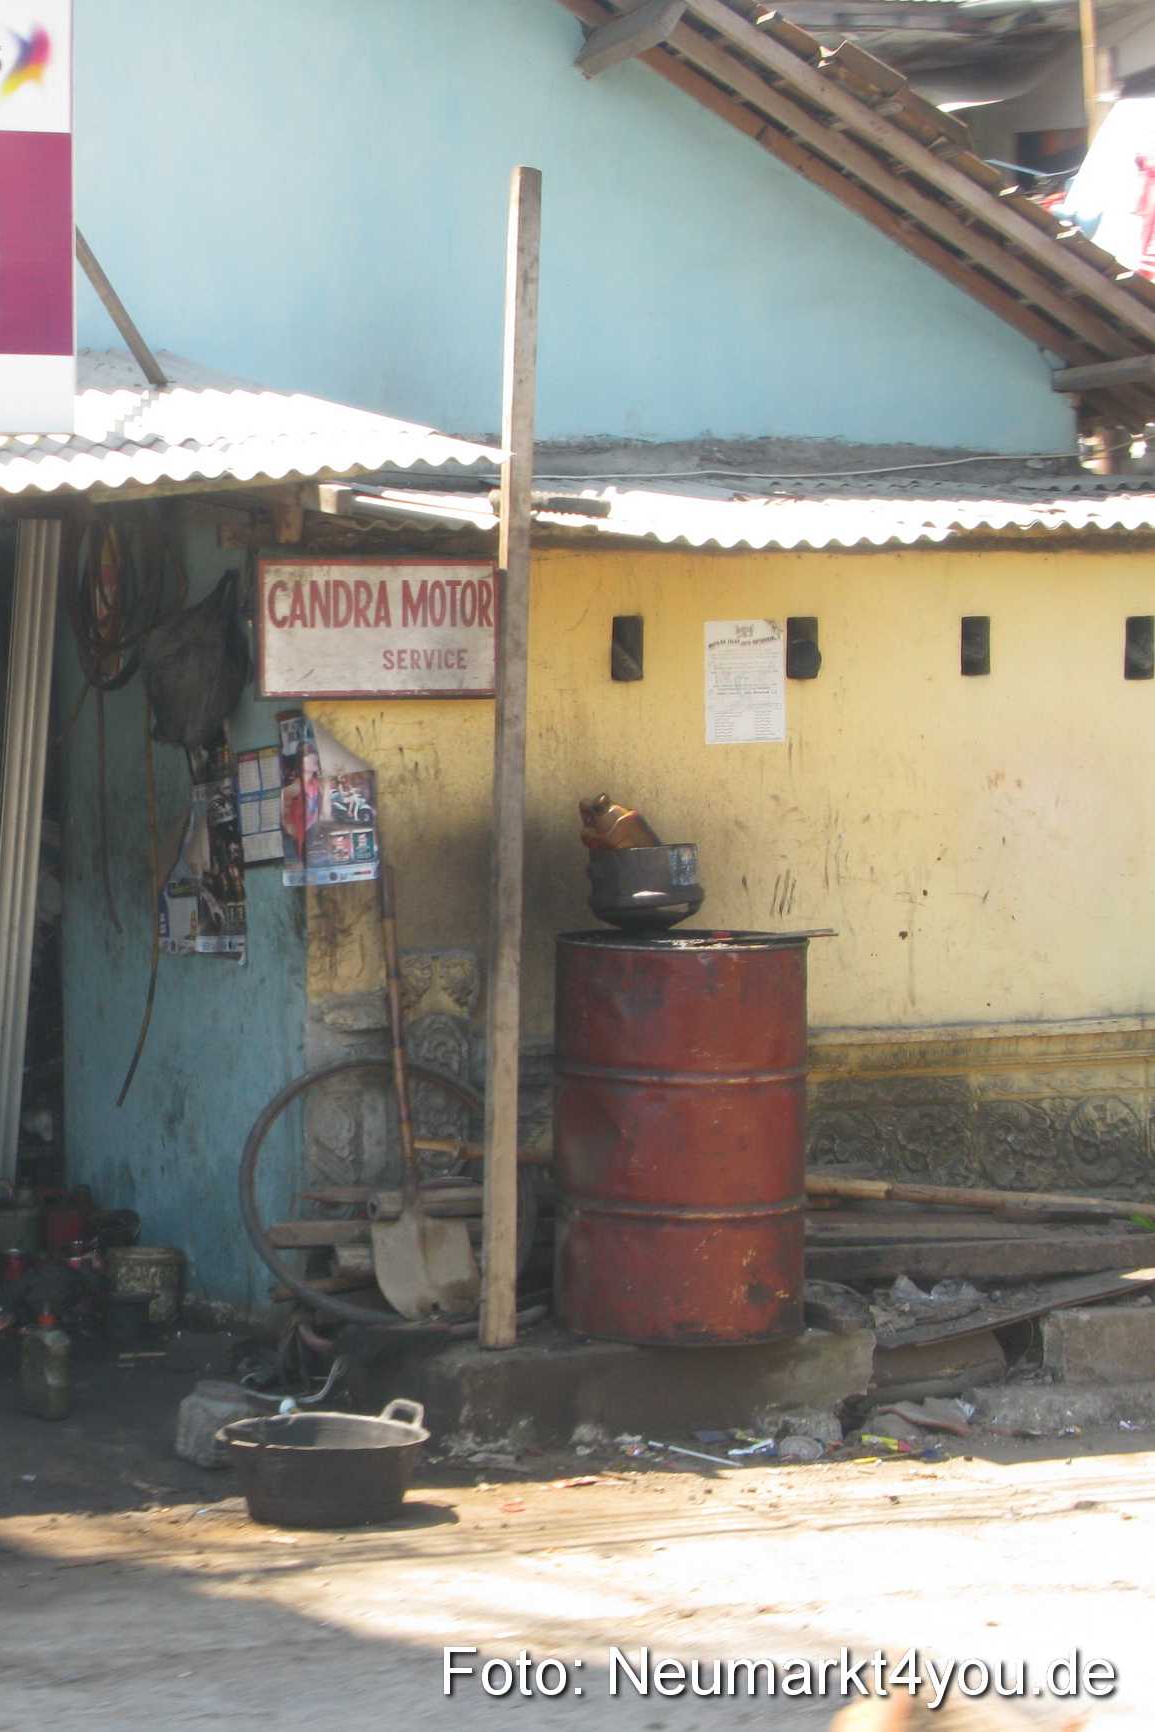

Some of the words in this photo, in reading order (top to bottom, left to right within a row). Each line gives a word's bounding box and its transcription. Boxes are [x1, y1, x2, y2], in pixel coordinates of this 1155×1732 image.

[267, 579, 392, 630] CANDRA
[401, 579, 495, 630] MOTOR
[382, 648, 469, 672] SERVICE
